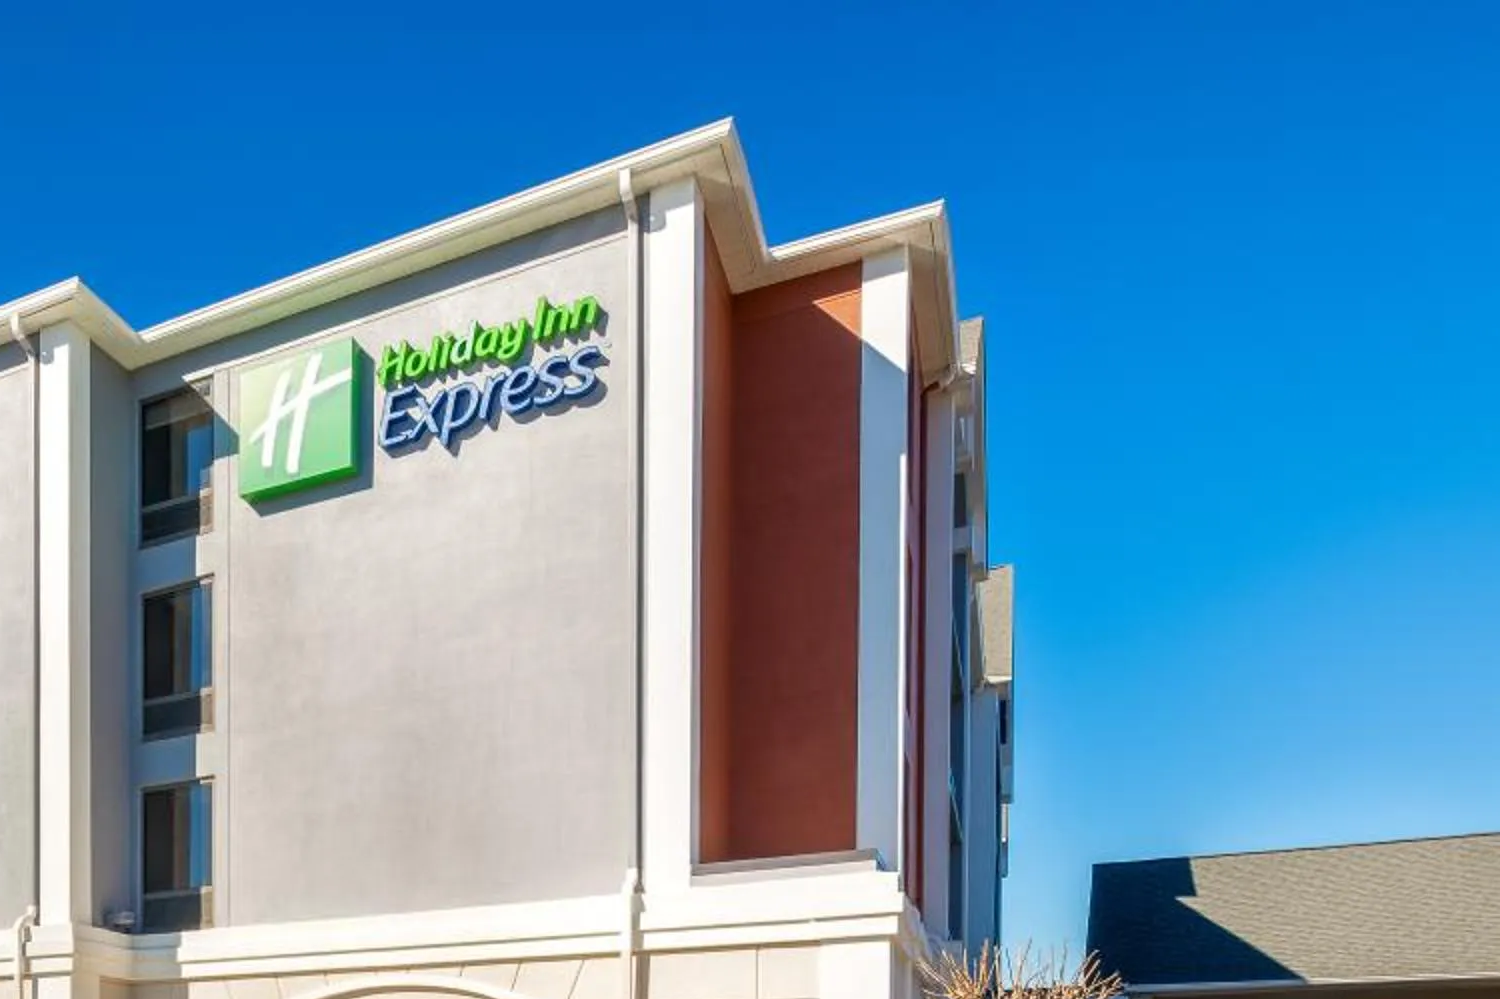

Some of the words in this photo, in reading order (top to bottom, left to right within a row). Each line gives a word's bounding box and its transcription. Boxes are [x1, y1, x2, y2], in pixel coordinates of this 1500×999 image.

[377, 320, 527, 386] Holiday
[532, 295, 599, 341] Inn
[378, 345, 602, 448] Express
